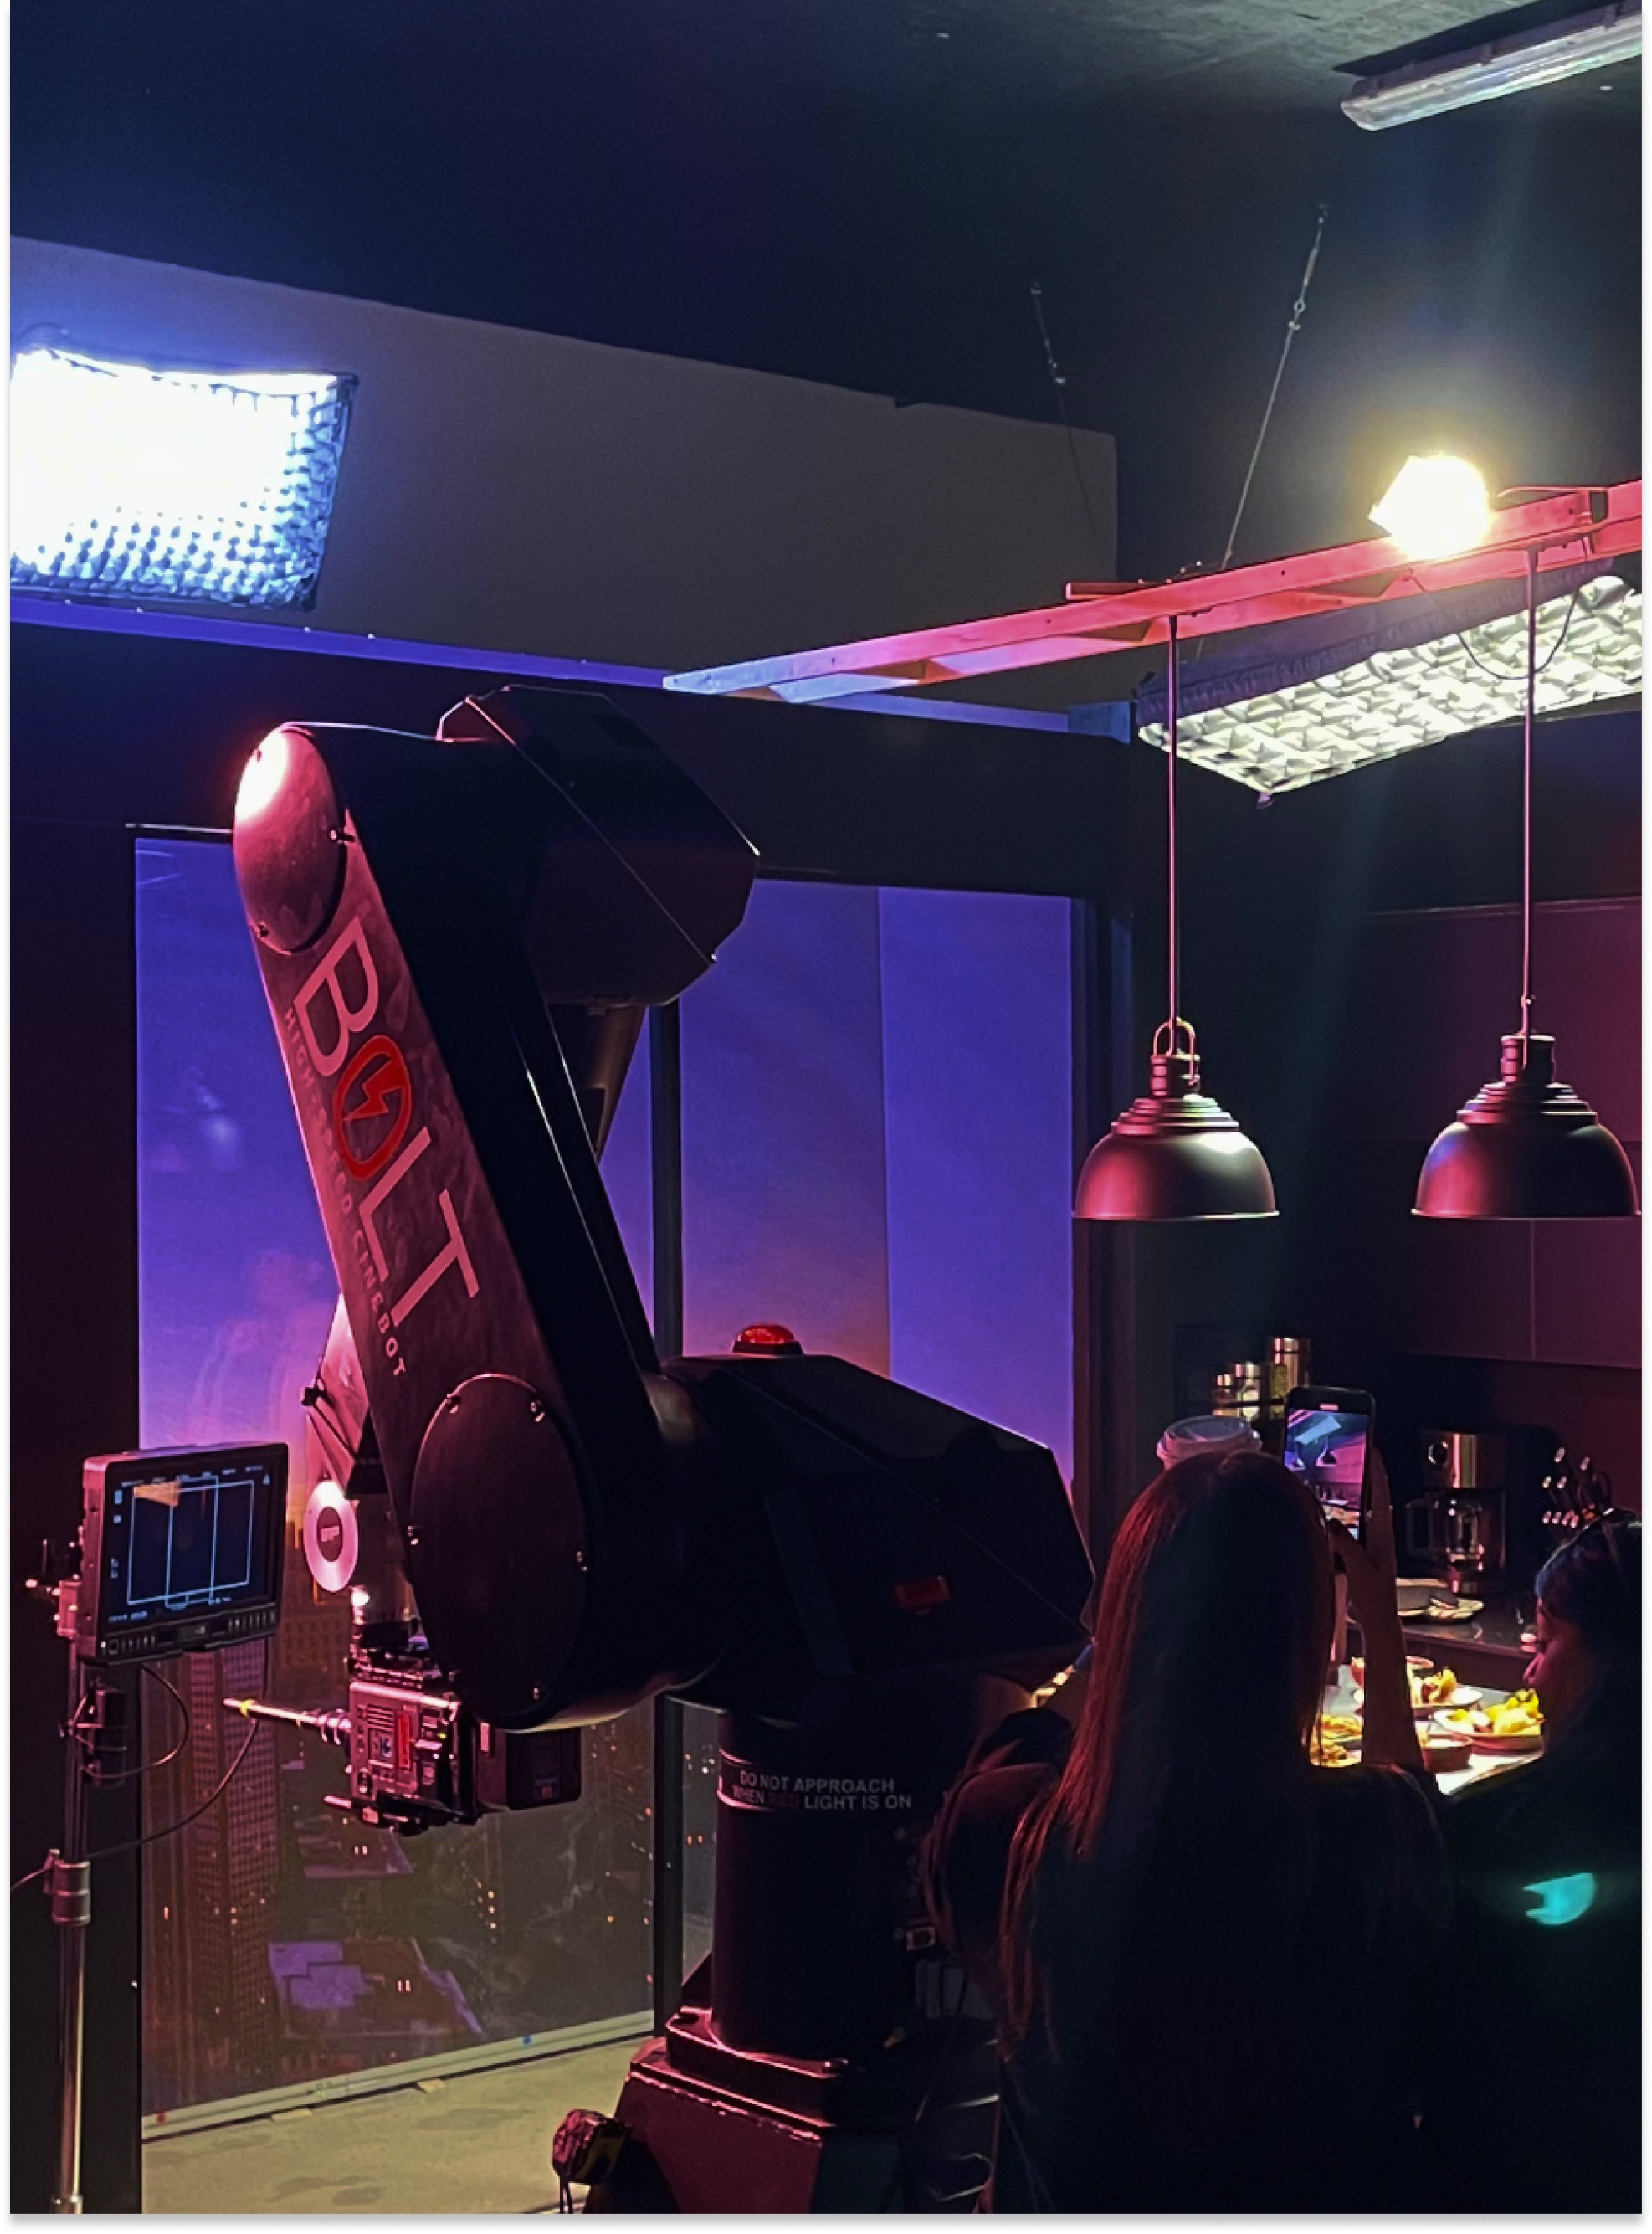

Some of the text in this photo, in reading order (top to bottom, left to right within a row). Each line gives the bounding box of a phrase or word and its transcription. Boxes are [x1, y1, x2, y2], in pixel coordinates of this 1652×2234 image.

[294, 917, 480, 1327] BOLT
[352, 1230, 407, 1377] CINEBOT
[732, 1785, 765, 1803] WHEN
[804, 1795, 858, 1810] LIGHT
[862, 1795, 880, 1810] IS
[885, 1794, 911, 1809] ON
[740, 1770, 895, 1794] DO NOT APPROACH
